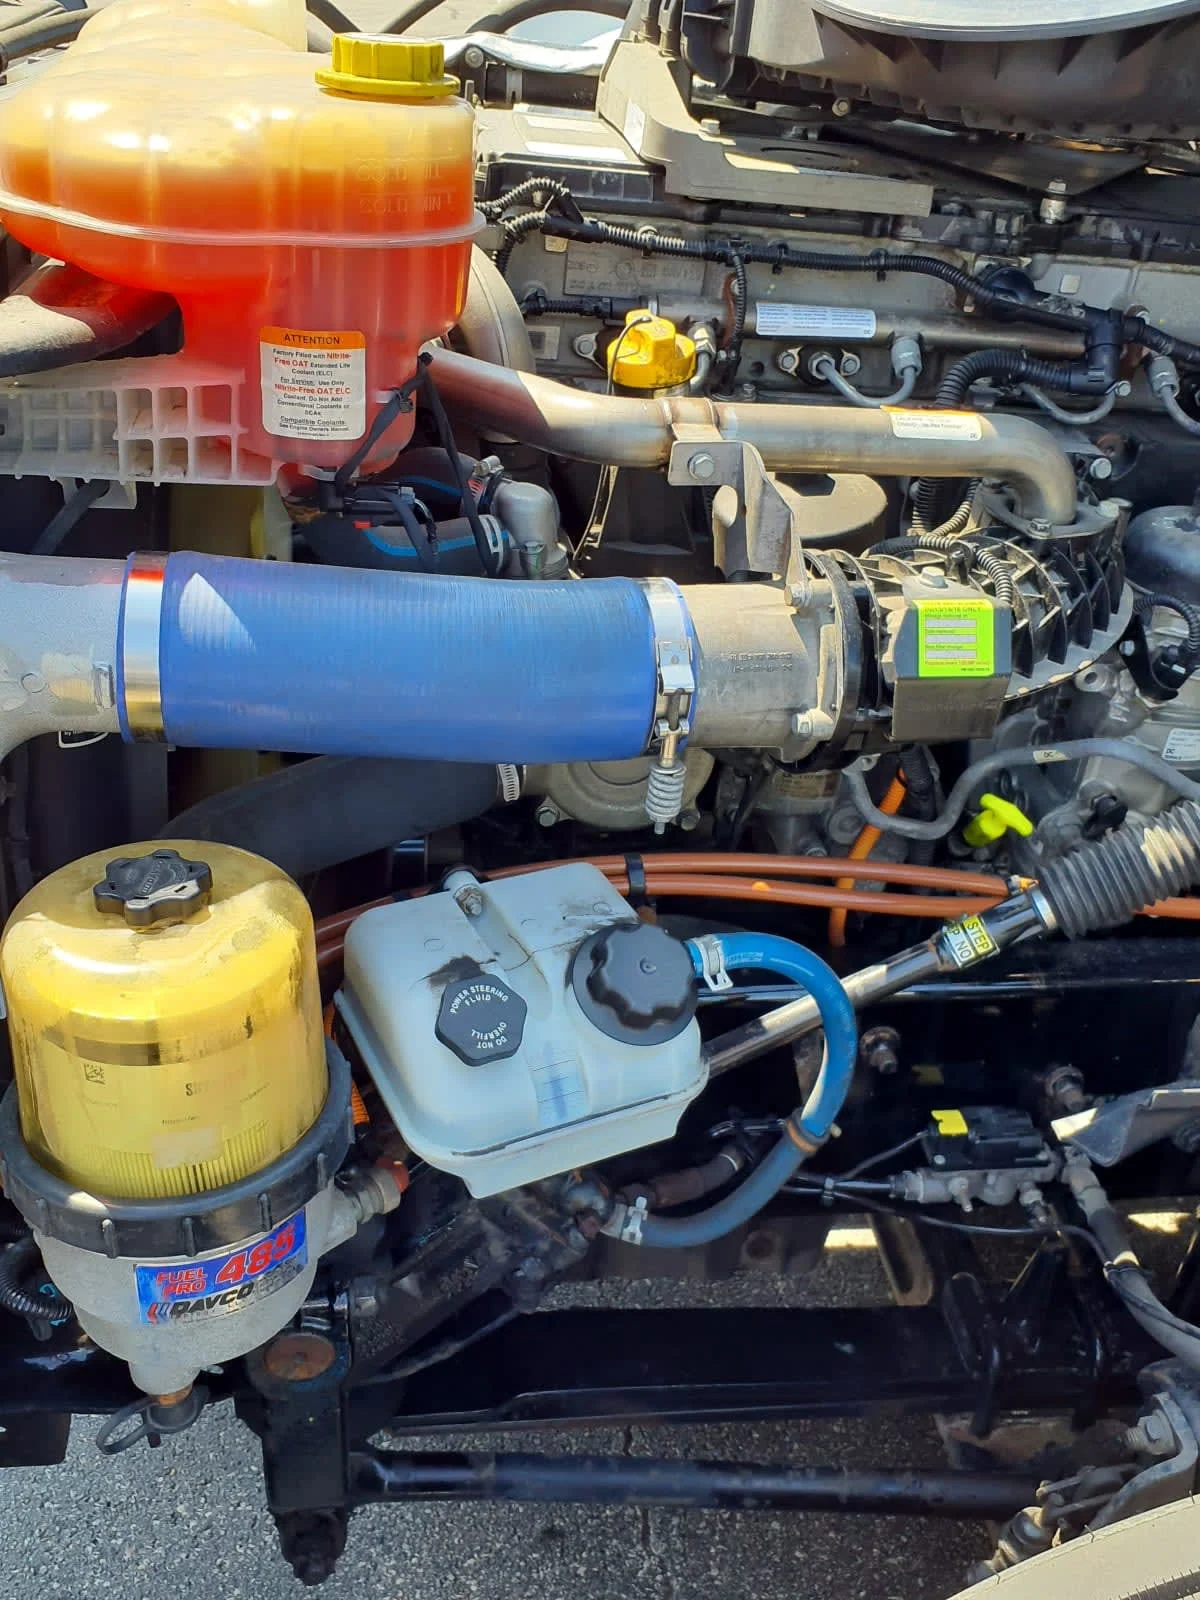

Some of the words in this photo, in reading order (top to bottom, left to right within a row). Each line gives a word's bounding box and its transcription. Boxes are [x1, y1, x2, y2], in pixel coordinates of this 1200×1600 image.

[284, 333, 341, 345] ATTENTION
[272, 348, 294, 358] Factory
[274, 357, 291, 366] Free
[292, 359, 309, 368] OAT
[310, 361, 338, 369] Extended
[291, 368, 315, 376] Coolant
[316, 369, 333, 377] (ELC)
[274, 383, 315, 395] Nitrite-Free
[316, 387, 333, 395] OAT
[335, 387, 351, 395] ELC
[967, 921, 991, 950] STEP
[955, 940, 972, 959] NO
[449, 989, 470, 1014] POWER
[469, 984, 509, 1002] STEERING
[464, 993, 492, 1007] FLUID
[471, 1021, 507, 1040] OVERFILL
[477, 1041, 495, 1049] NOT
[495, 1035, 509, 1046] DO
[215, 1223, 297, 1285] 485
[156, 1267, 208, 1286] FUEL
[162, 1281, 207, 1301] PRO
